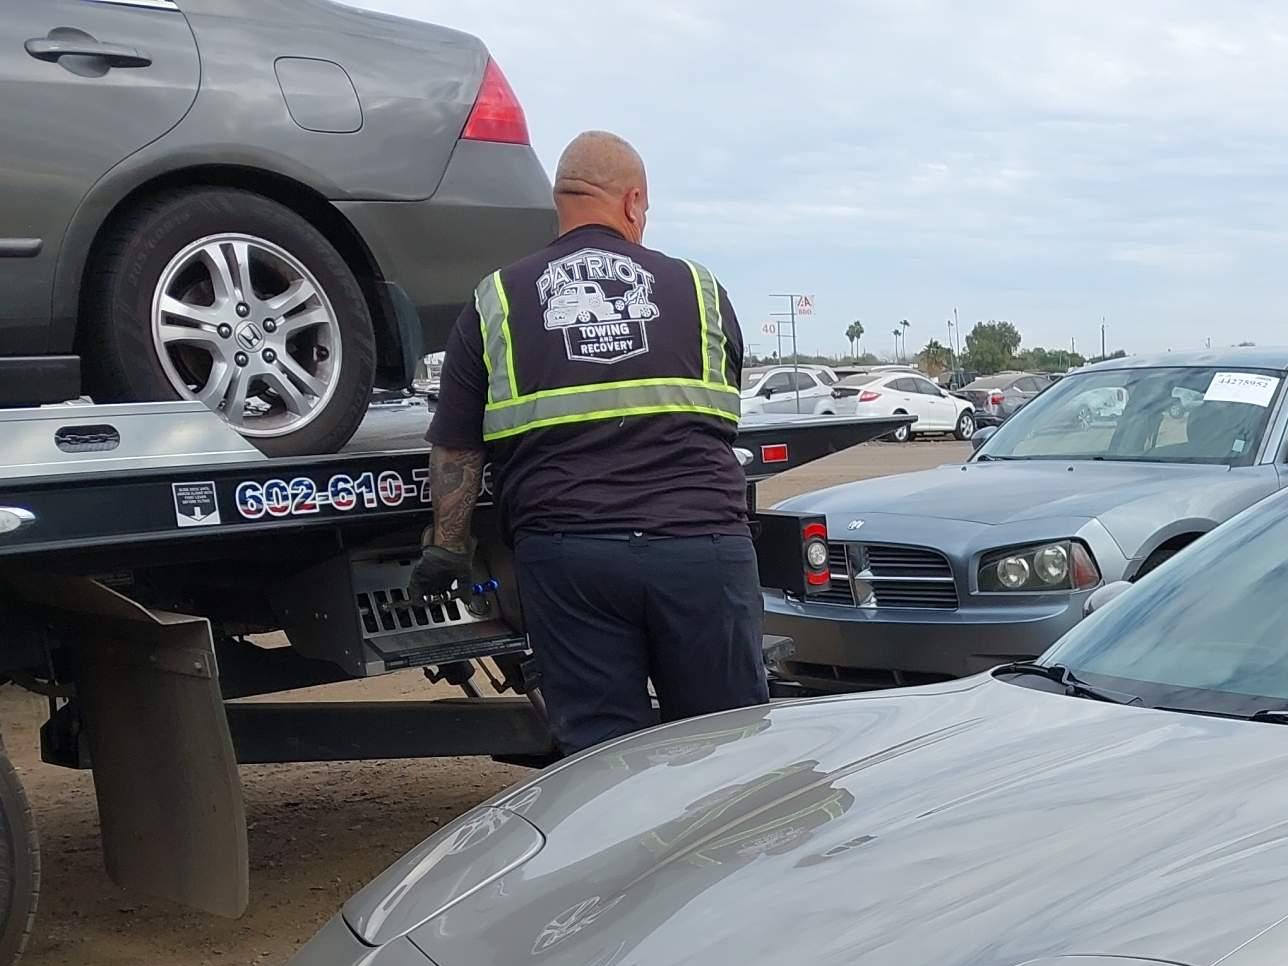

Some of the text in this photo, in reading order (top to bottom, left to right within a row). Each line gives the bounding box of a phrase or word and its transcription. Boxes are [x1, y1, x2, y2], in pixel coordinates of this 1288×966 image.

[536, 255, 656, 306] PATRIOT
[579, 323, 630, 339] TOWING
[762, 324, 776, 334] 40
[580, 340, 633, 355] RECOVERY
